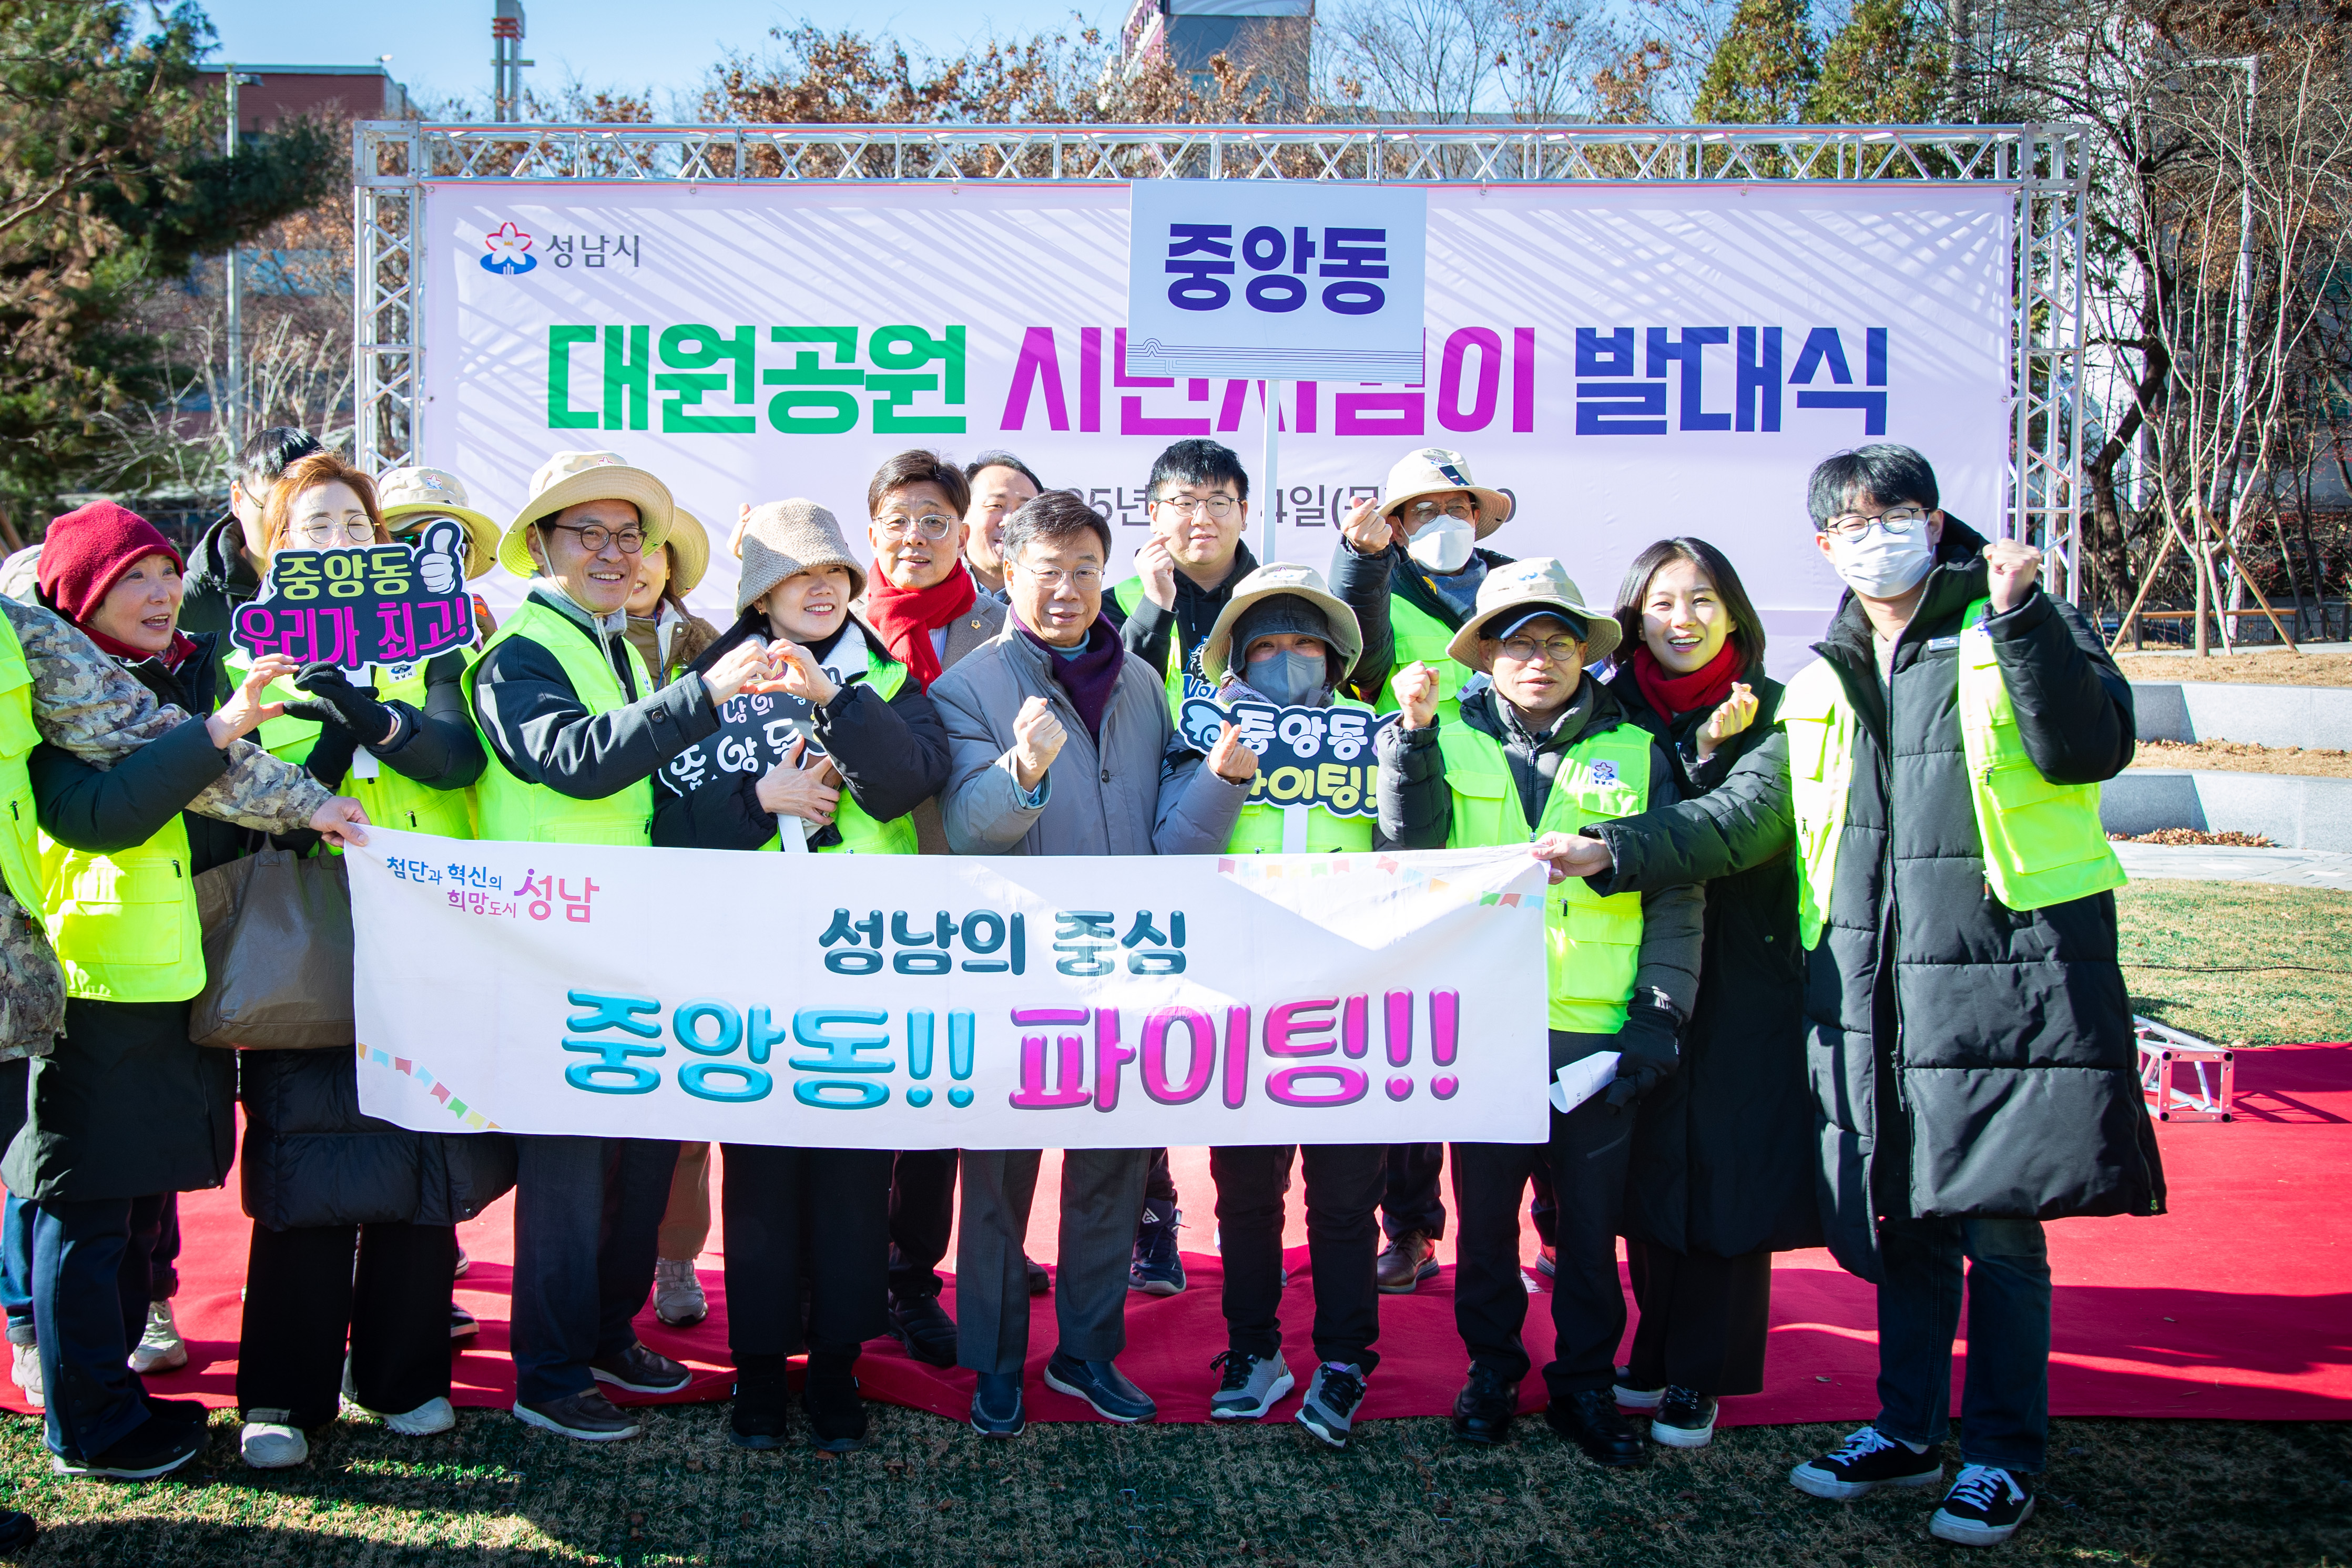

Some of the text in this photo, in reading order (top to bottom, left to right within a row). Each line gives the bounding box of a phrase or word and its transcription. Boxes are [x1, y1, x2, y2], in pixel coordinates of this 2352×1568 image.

[546, 236, 638, 267] 성남시
[1165, 223, 1389, 314] 중앙동
[548, 324, 966, 434] 대원공원
[1575, 327, 1887, 436] 발대식
[279, 552, 412, 600] 중앙동
[239, 597, 467, 667] 우리가 최고!
[1237, 709, 1368, 760] 중앙동
[386, 857, 502, 890] 첨단과 혁신의
[447, 869, 599, 923] 희망도시 성남
[819, 908, 1186, 976] 성남의 중심
[561, 986, 1460, 1113] 중앙동!! 파이팅!!
